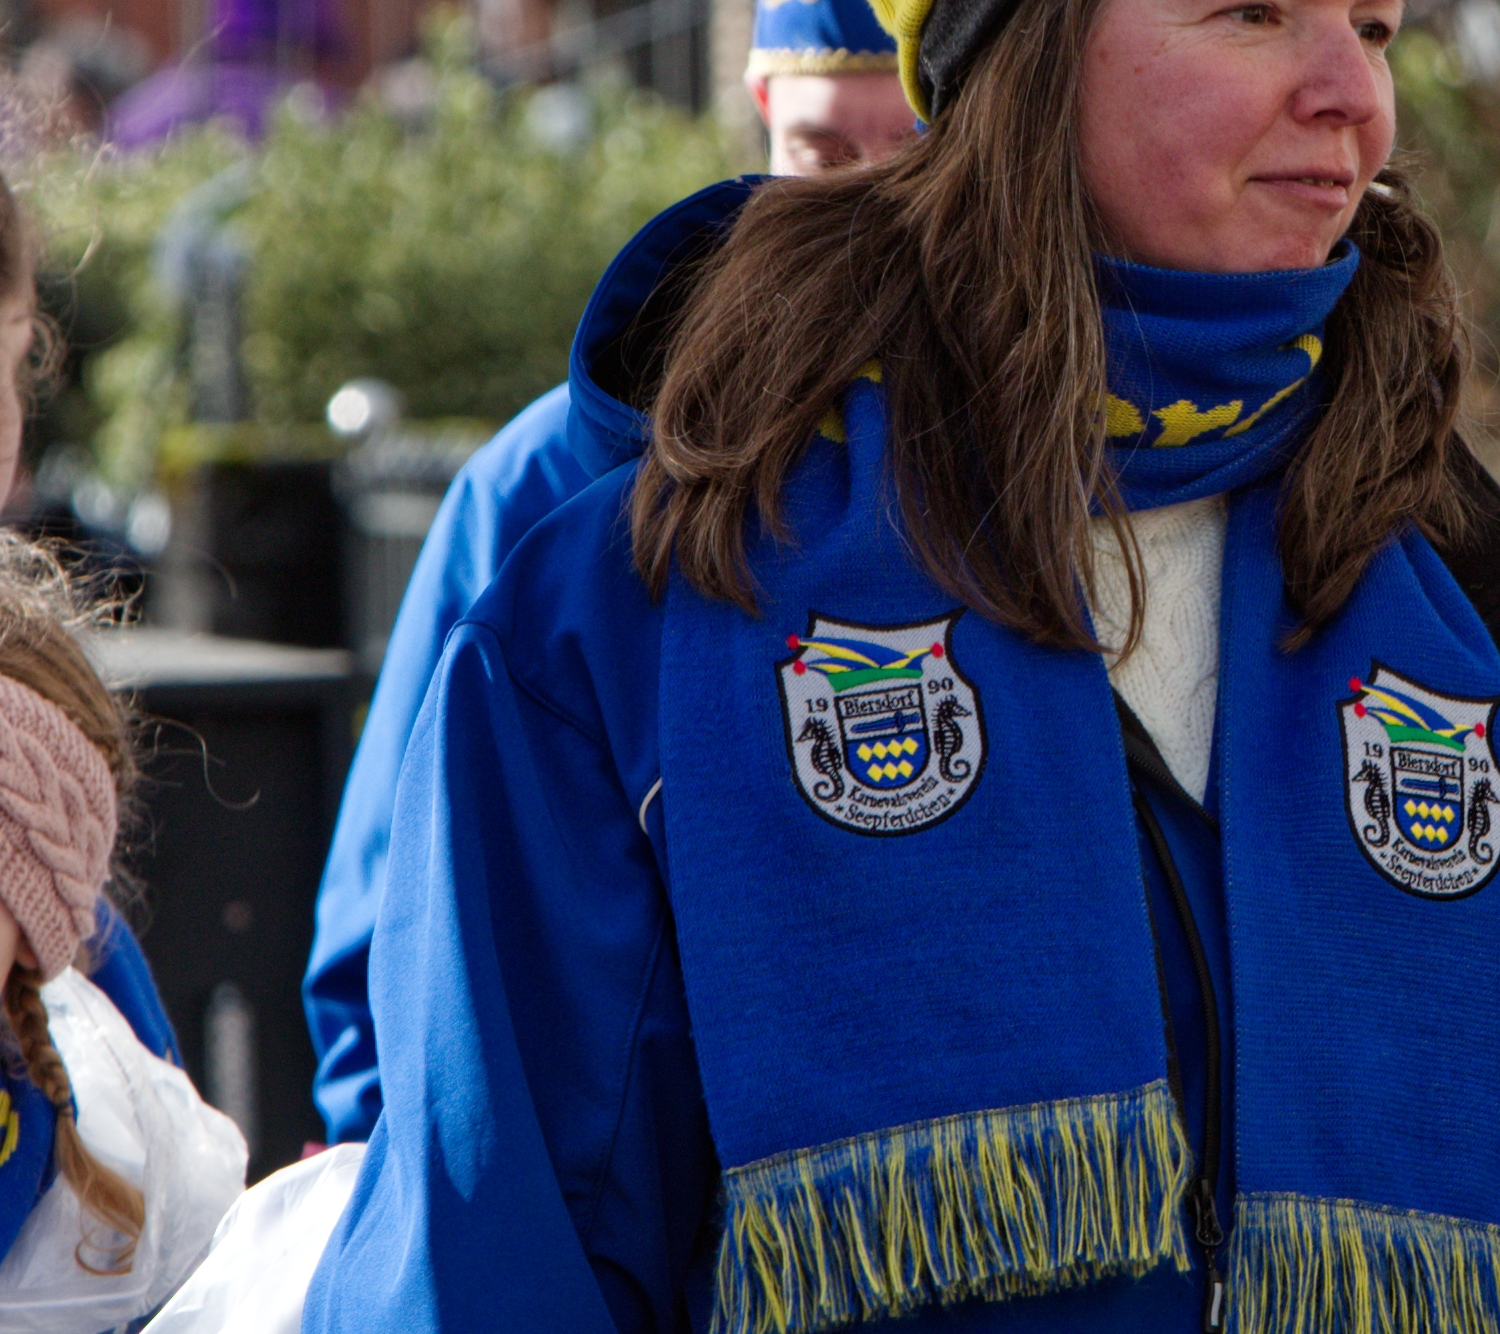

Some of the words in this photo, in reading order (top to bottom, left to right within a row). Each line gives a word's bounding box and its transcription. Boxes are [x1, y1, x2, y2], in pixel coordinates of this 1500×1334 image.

[804, 697, 829, 714] 19
[926, 677, 954, 694] 90
[843, 689, 915, 715] Biersdorf
[1362, 741, 1383, 759] 19
[1468, 757, 1489, 773] 90
[1397, 752, 1458, 776] Biersdorf
[847, 775, 939, 809] Karnevalsverein
[844, 793, 950, 830] Seepferdchen
[1385, 855, 1473, 891] Seepferdchen
